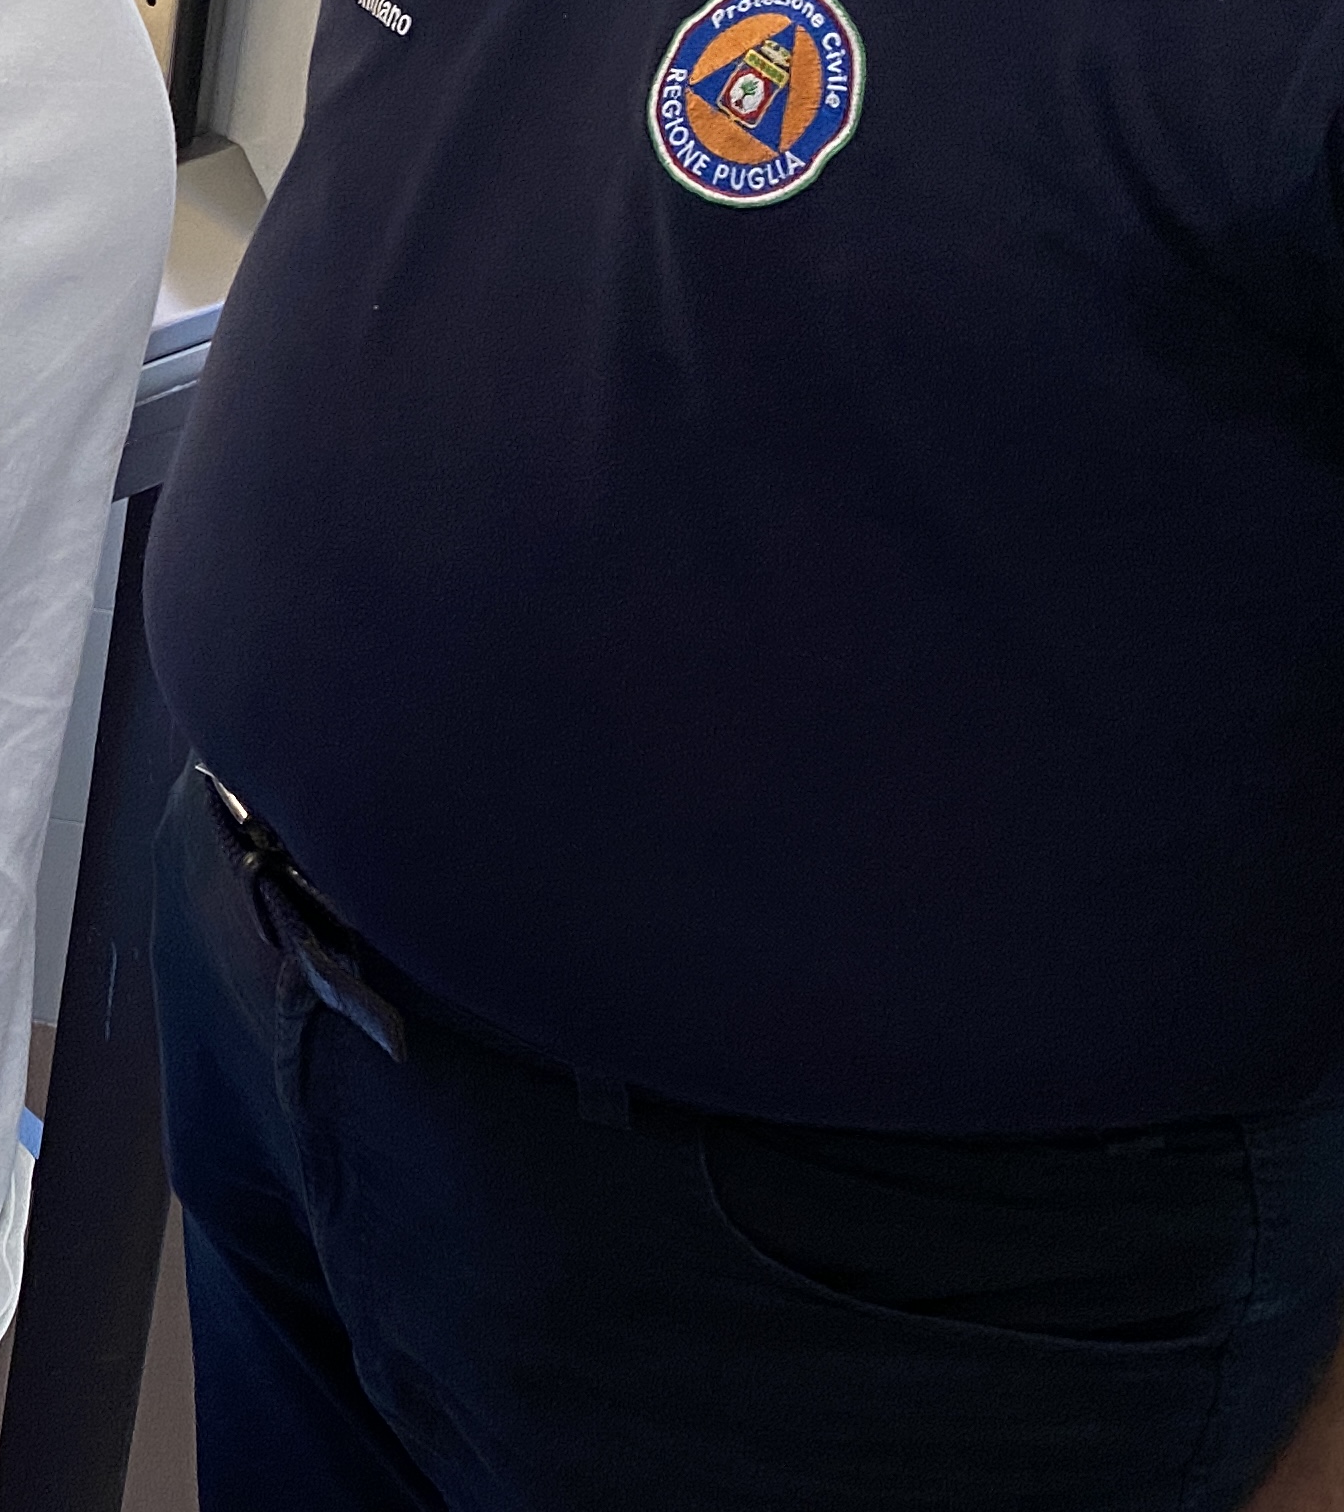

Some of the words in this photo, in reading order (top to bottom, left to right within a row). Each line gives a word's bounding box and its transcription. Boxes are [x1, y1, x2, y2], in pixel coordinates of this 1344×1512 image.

[822, 32, 848, 109] Civile
[662, 67, 711, 176] REGIONE
[712, 151, 806, 191] PUGLIA
